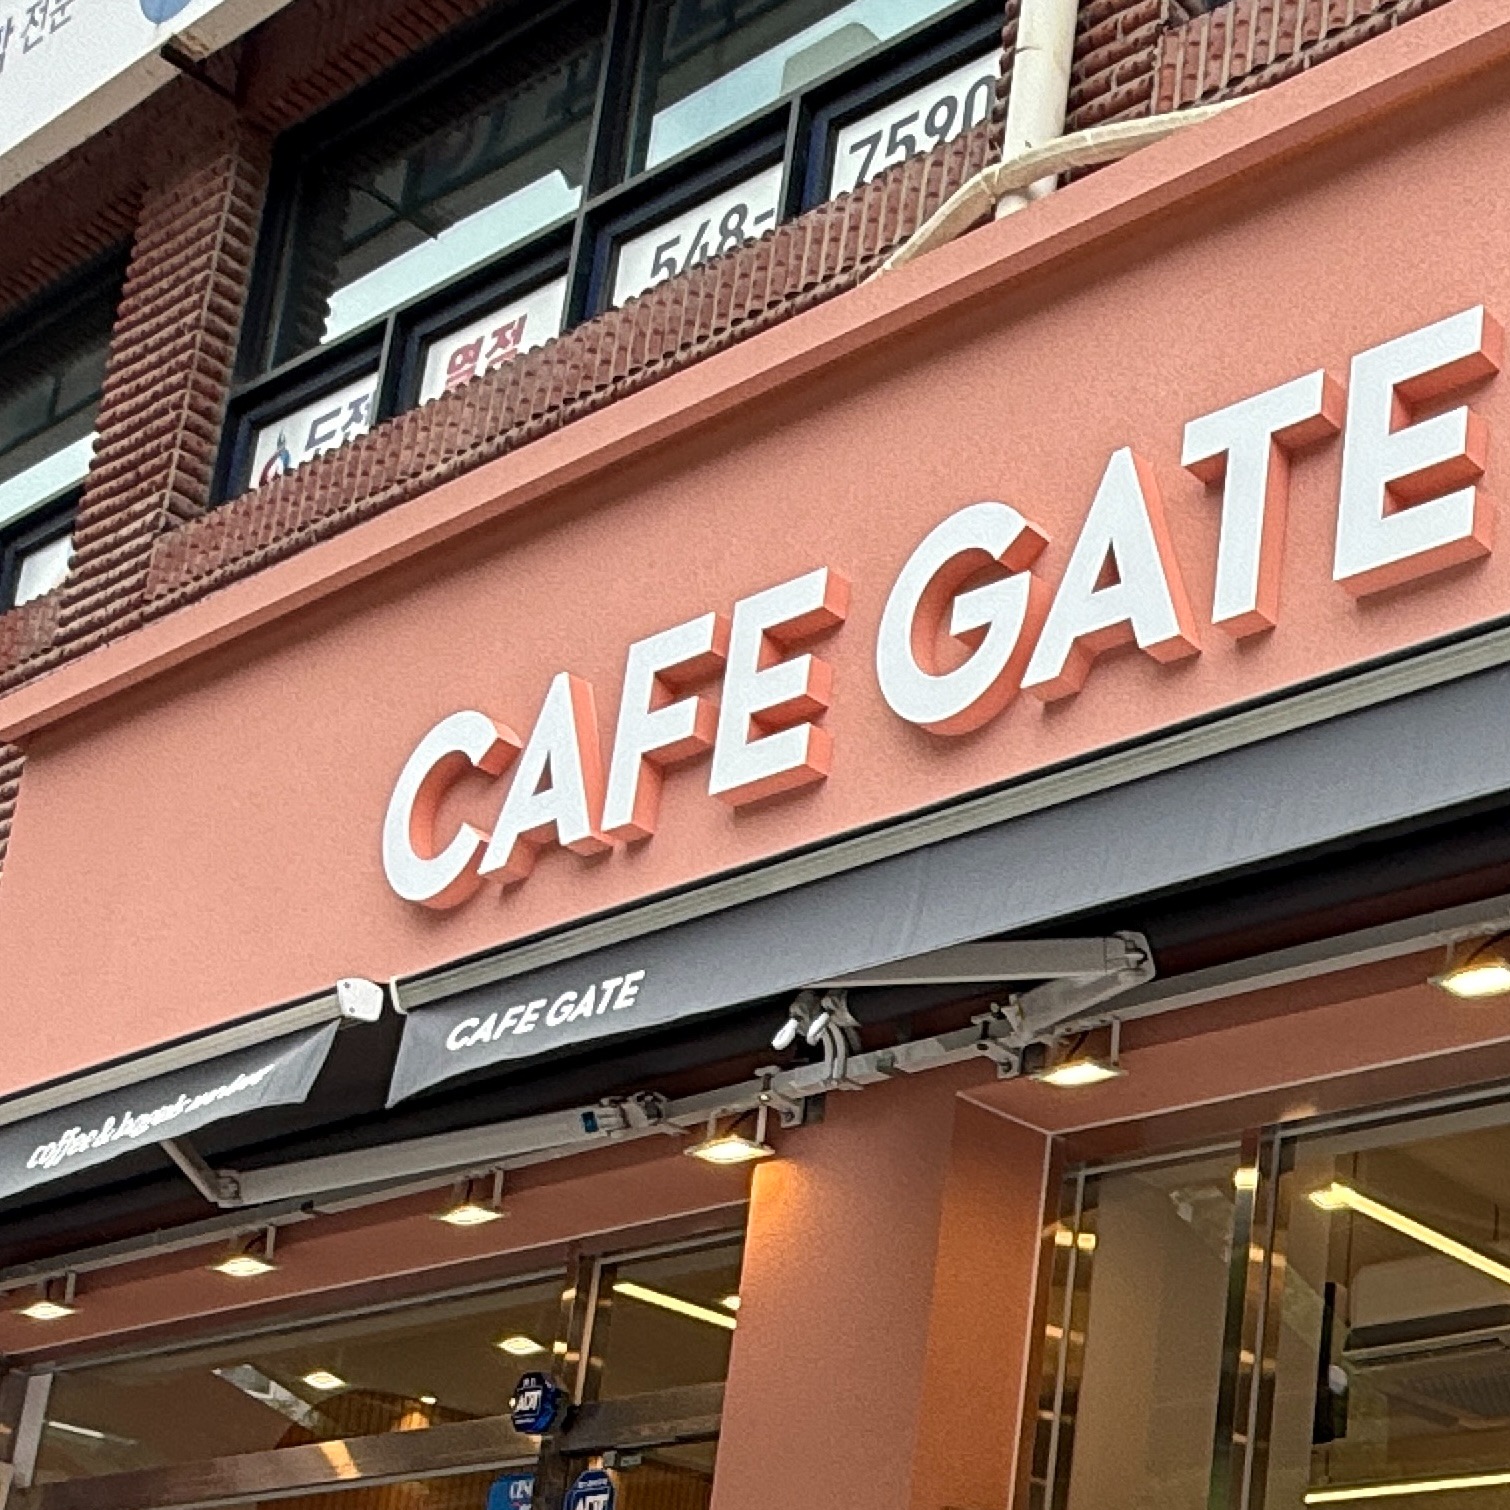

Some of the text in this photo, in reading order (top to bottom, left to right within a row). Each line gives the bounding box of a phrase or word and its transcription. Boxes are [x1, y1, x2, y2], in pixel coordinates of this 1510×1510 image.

[382, 305, 1492, 908] CAFE GATE
[446, 969, 646, 1052] CAFE GATE
[516, 1390, 542, 1412] ADT
